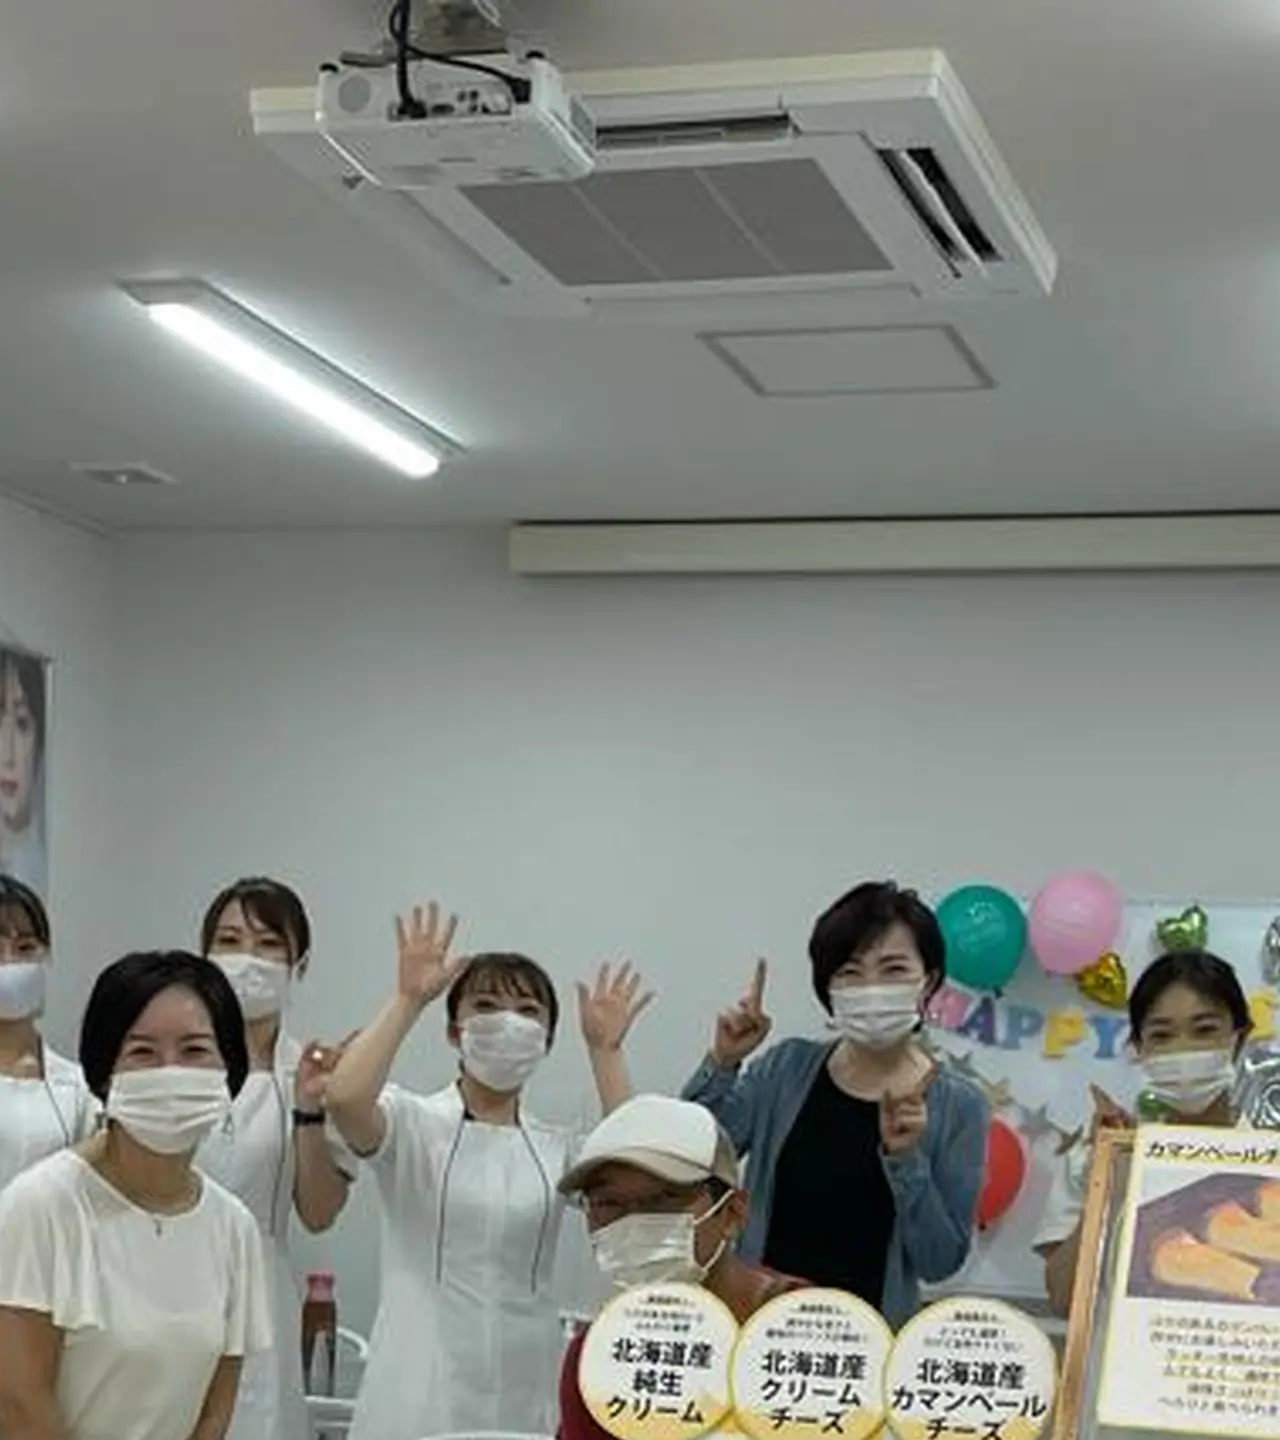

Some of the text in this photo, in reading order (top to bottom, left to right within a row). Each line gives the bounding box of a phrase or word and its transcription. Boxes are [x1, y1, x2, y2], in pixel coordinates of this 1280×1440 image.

[612, 1337, 713, 1369] 北海道産
[761, 1349, 868, 1381] 北海道産
[915, 1357, 1025, 1390] 北海道産
[760, 1378, 861, 1407] クリーム
[892, 1386, 1047, 1418] カマンベール
[606, 1396, 704, 1424] クリーム
[771, 1406, 848, 1434] チーズ
